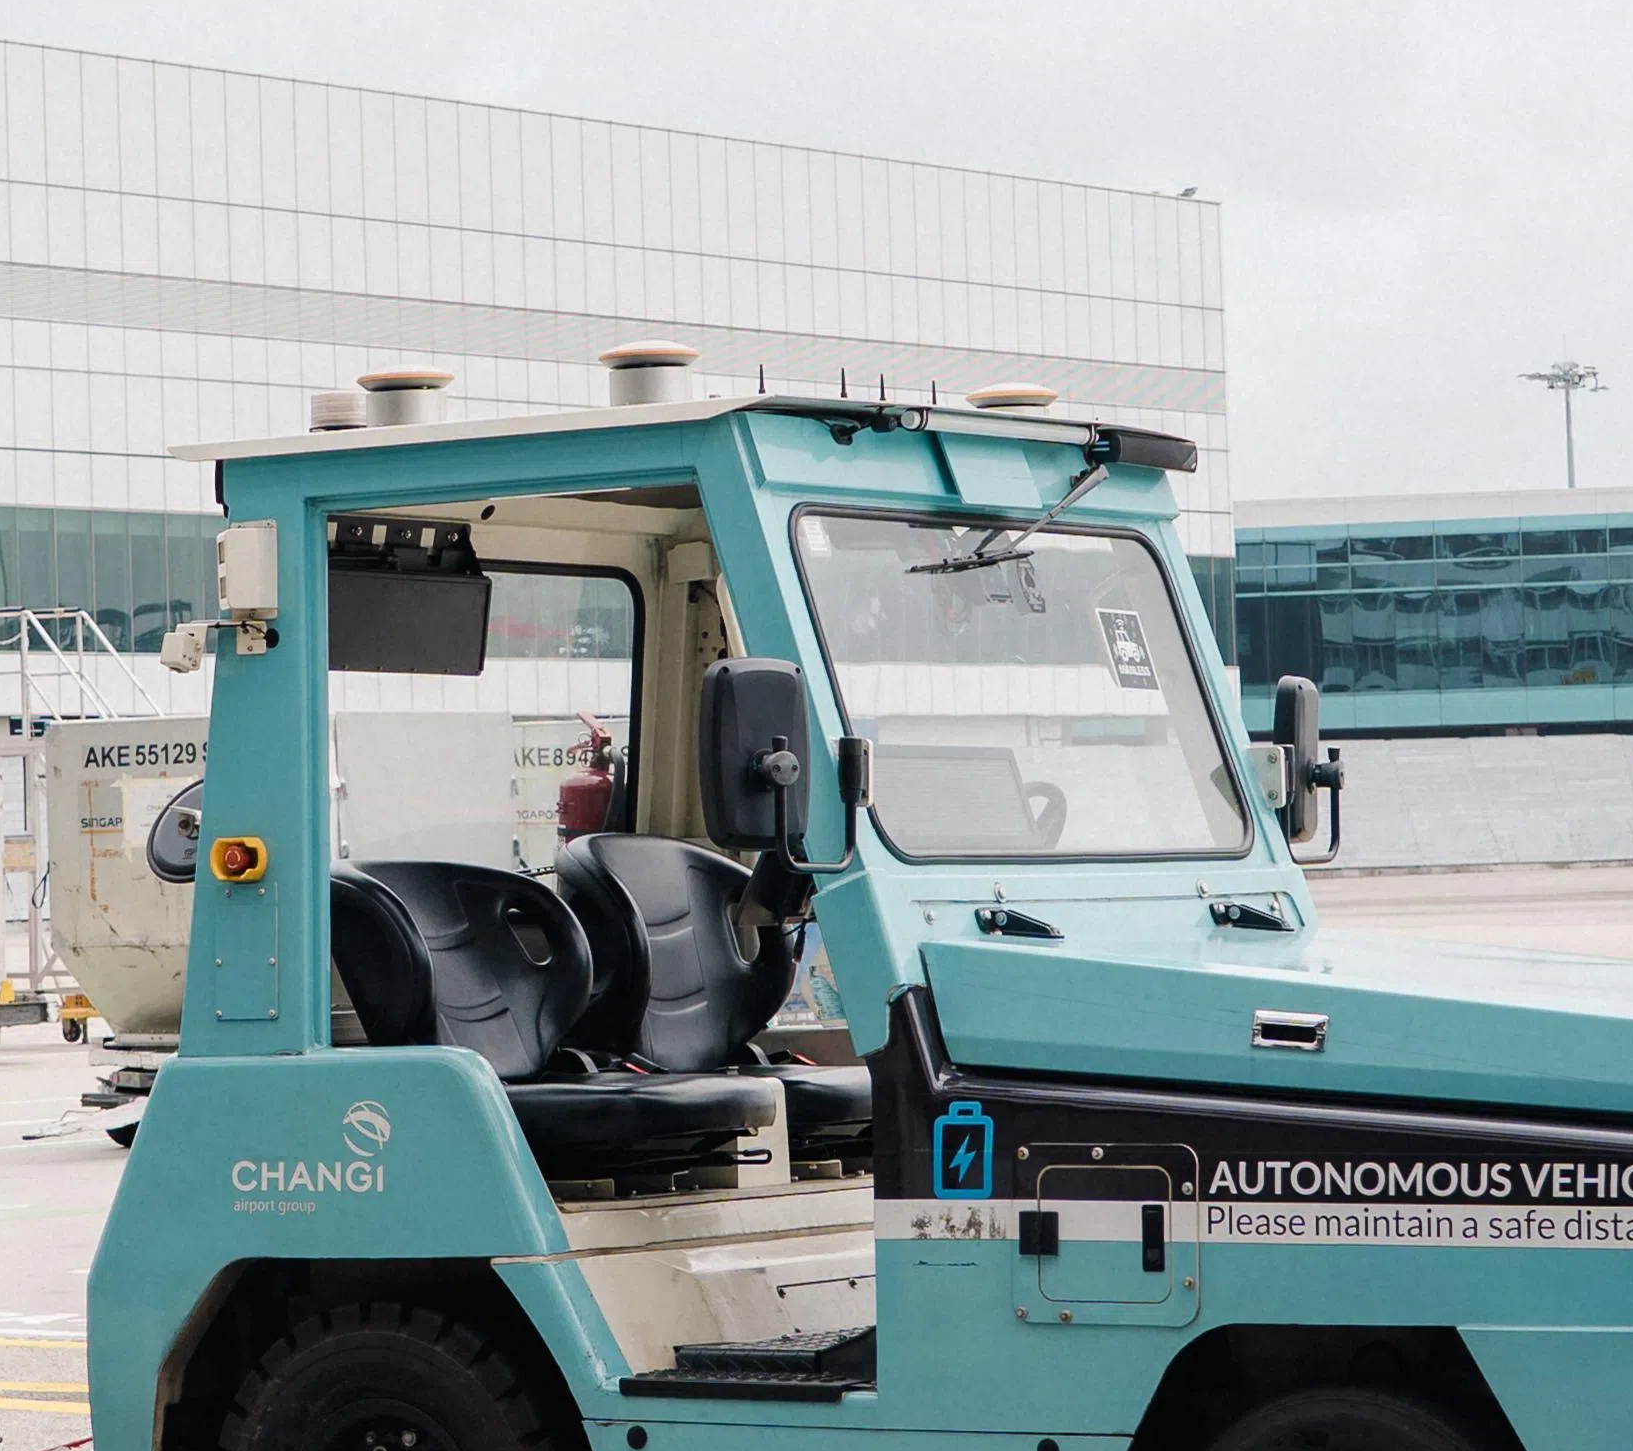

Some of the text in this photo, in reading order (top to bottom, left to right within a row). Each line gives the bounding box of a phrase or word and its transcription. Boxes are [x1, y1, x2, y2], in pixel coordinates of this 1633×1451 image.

[84, 746, 130, 768] AKE
[135, 743, 197, 766] 55129
[232, 1160, 384, 1193] CHANGI
[1209, 1161, 1512, 1198] AUTONOMOUS
[234, 1199, 316, 1215] airport group
[1207, 1206, 1306, 1236] Please
[1315, 1207, 1453, 1238] maintain
[1462, 1216, 1478, 1239] a
[1489, 1209, 1555, 1239] safe
